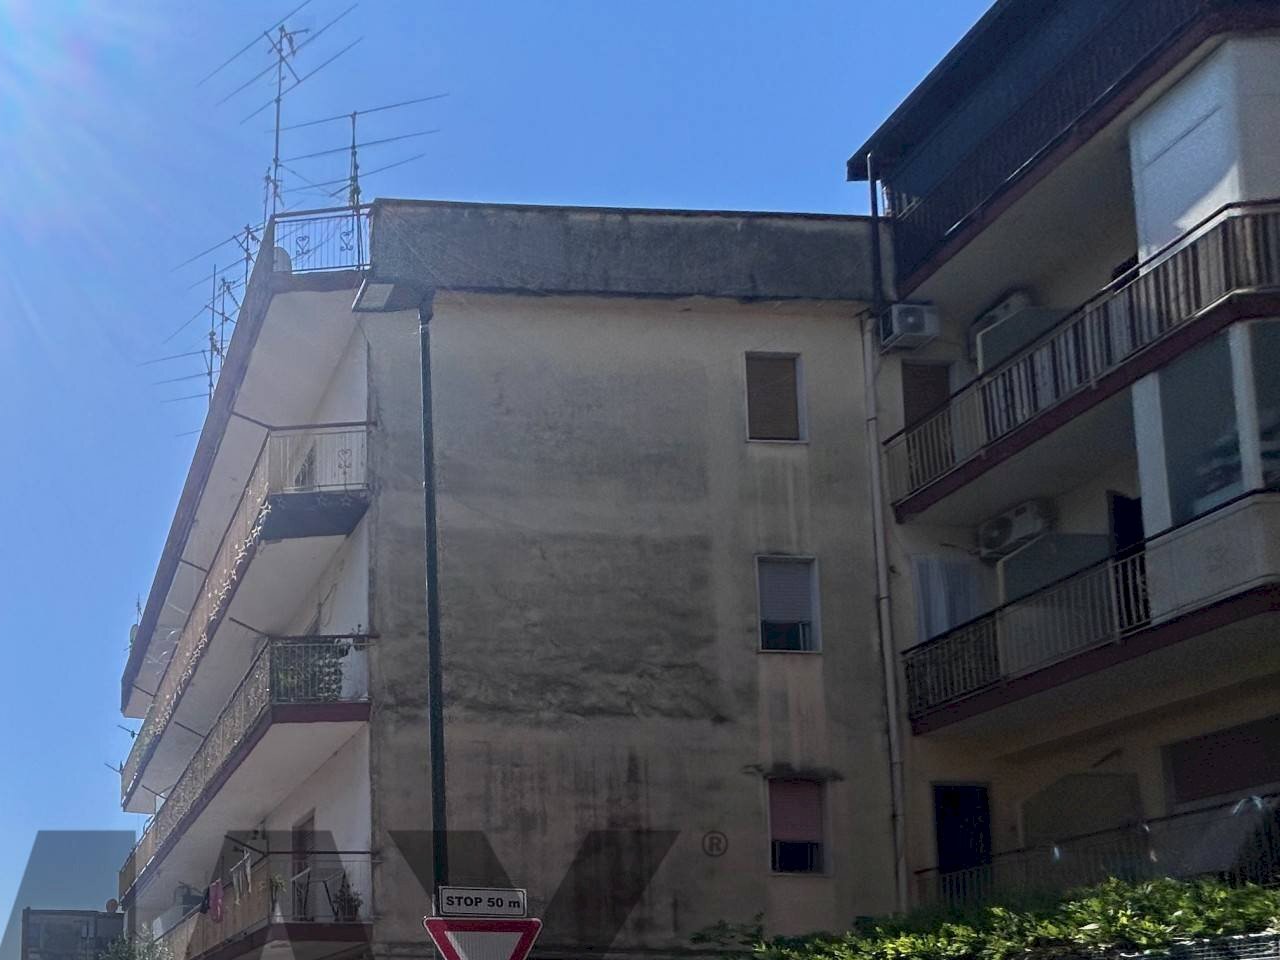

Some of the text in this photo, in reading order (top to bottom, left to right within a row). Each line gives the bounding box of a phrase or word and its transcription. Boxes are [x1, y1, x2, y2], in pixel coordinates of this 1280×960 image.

[446, 895, 521, 908] STOP 50 m
